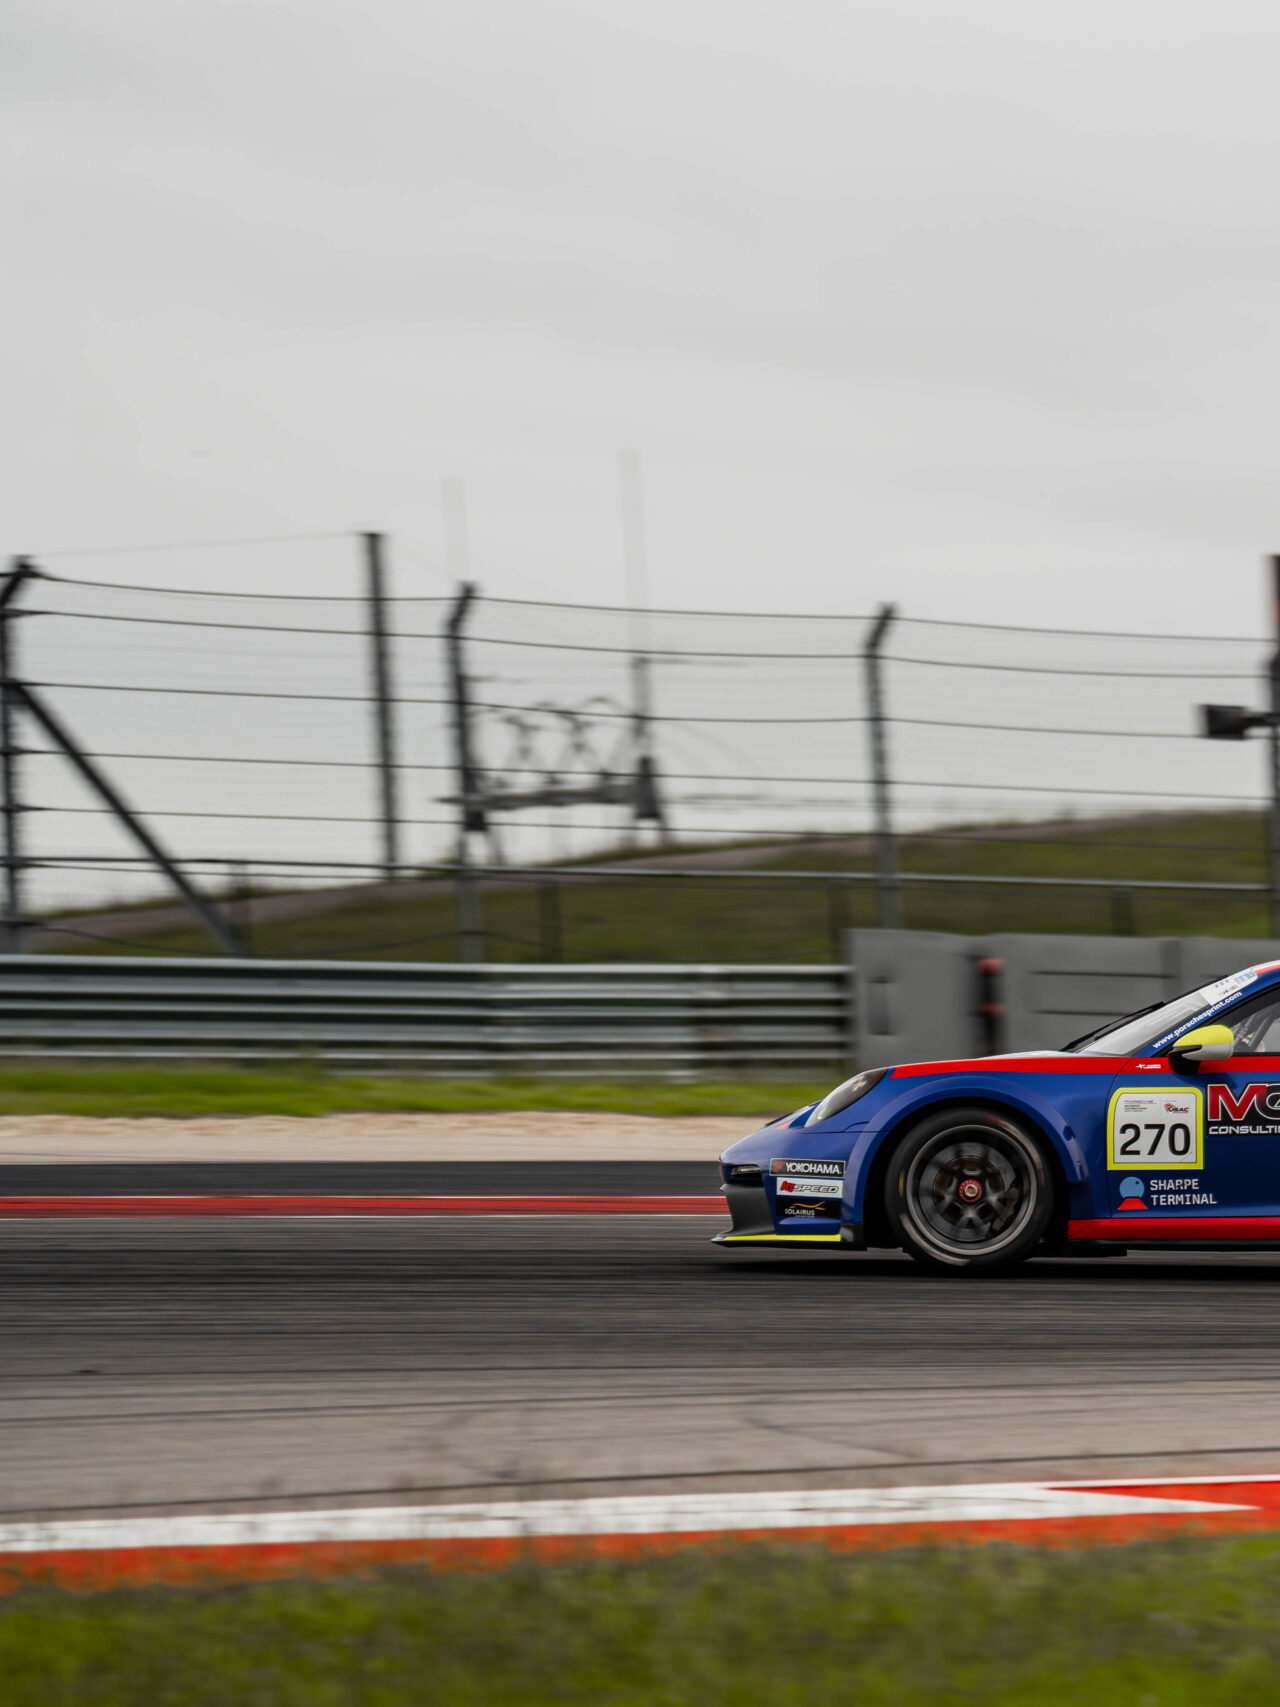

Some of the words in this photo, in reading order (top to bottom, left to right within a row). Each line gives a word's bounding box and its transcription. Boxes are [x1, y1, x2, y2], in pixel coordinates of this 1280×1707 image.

[1152, 991, 1242, 1048] www.porschesprint.com
[1119, 1122, 1191, 1156] 270
[786, 1162, 840, 1174] YOKOHAMA
[1149, 1178, 1200, 1190] SHARPE
[1150, 1193, 1217, 1206] TERMINAL
